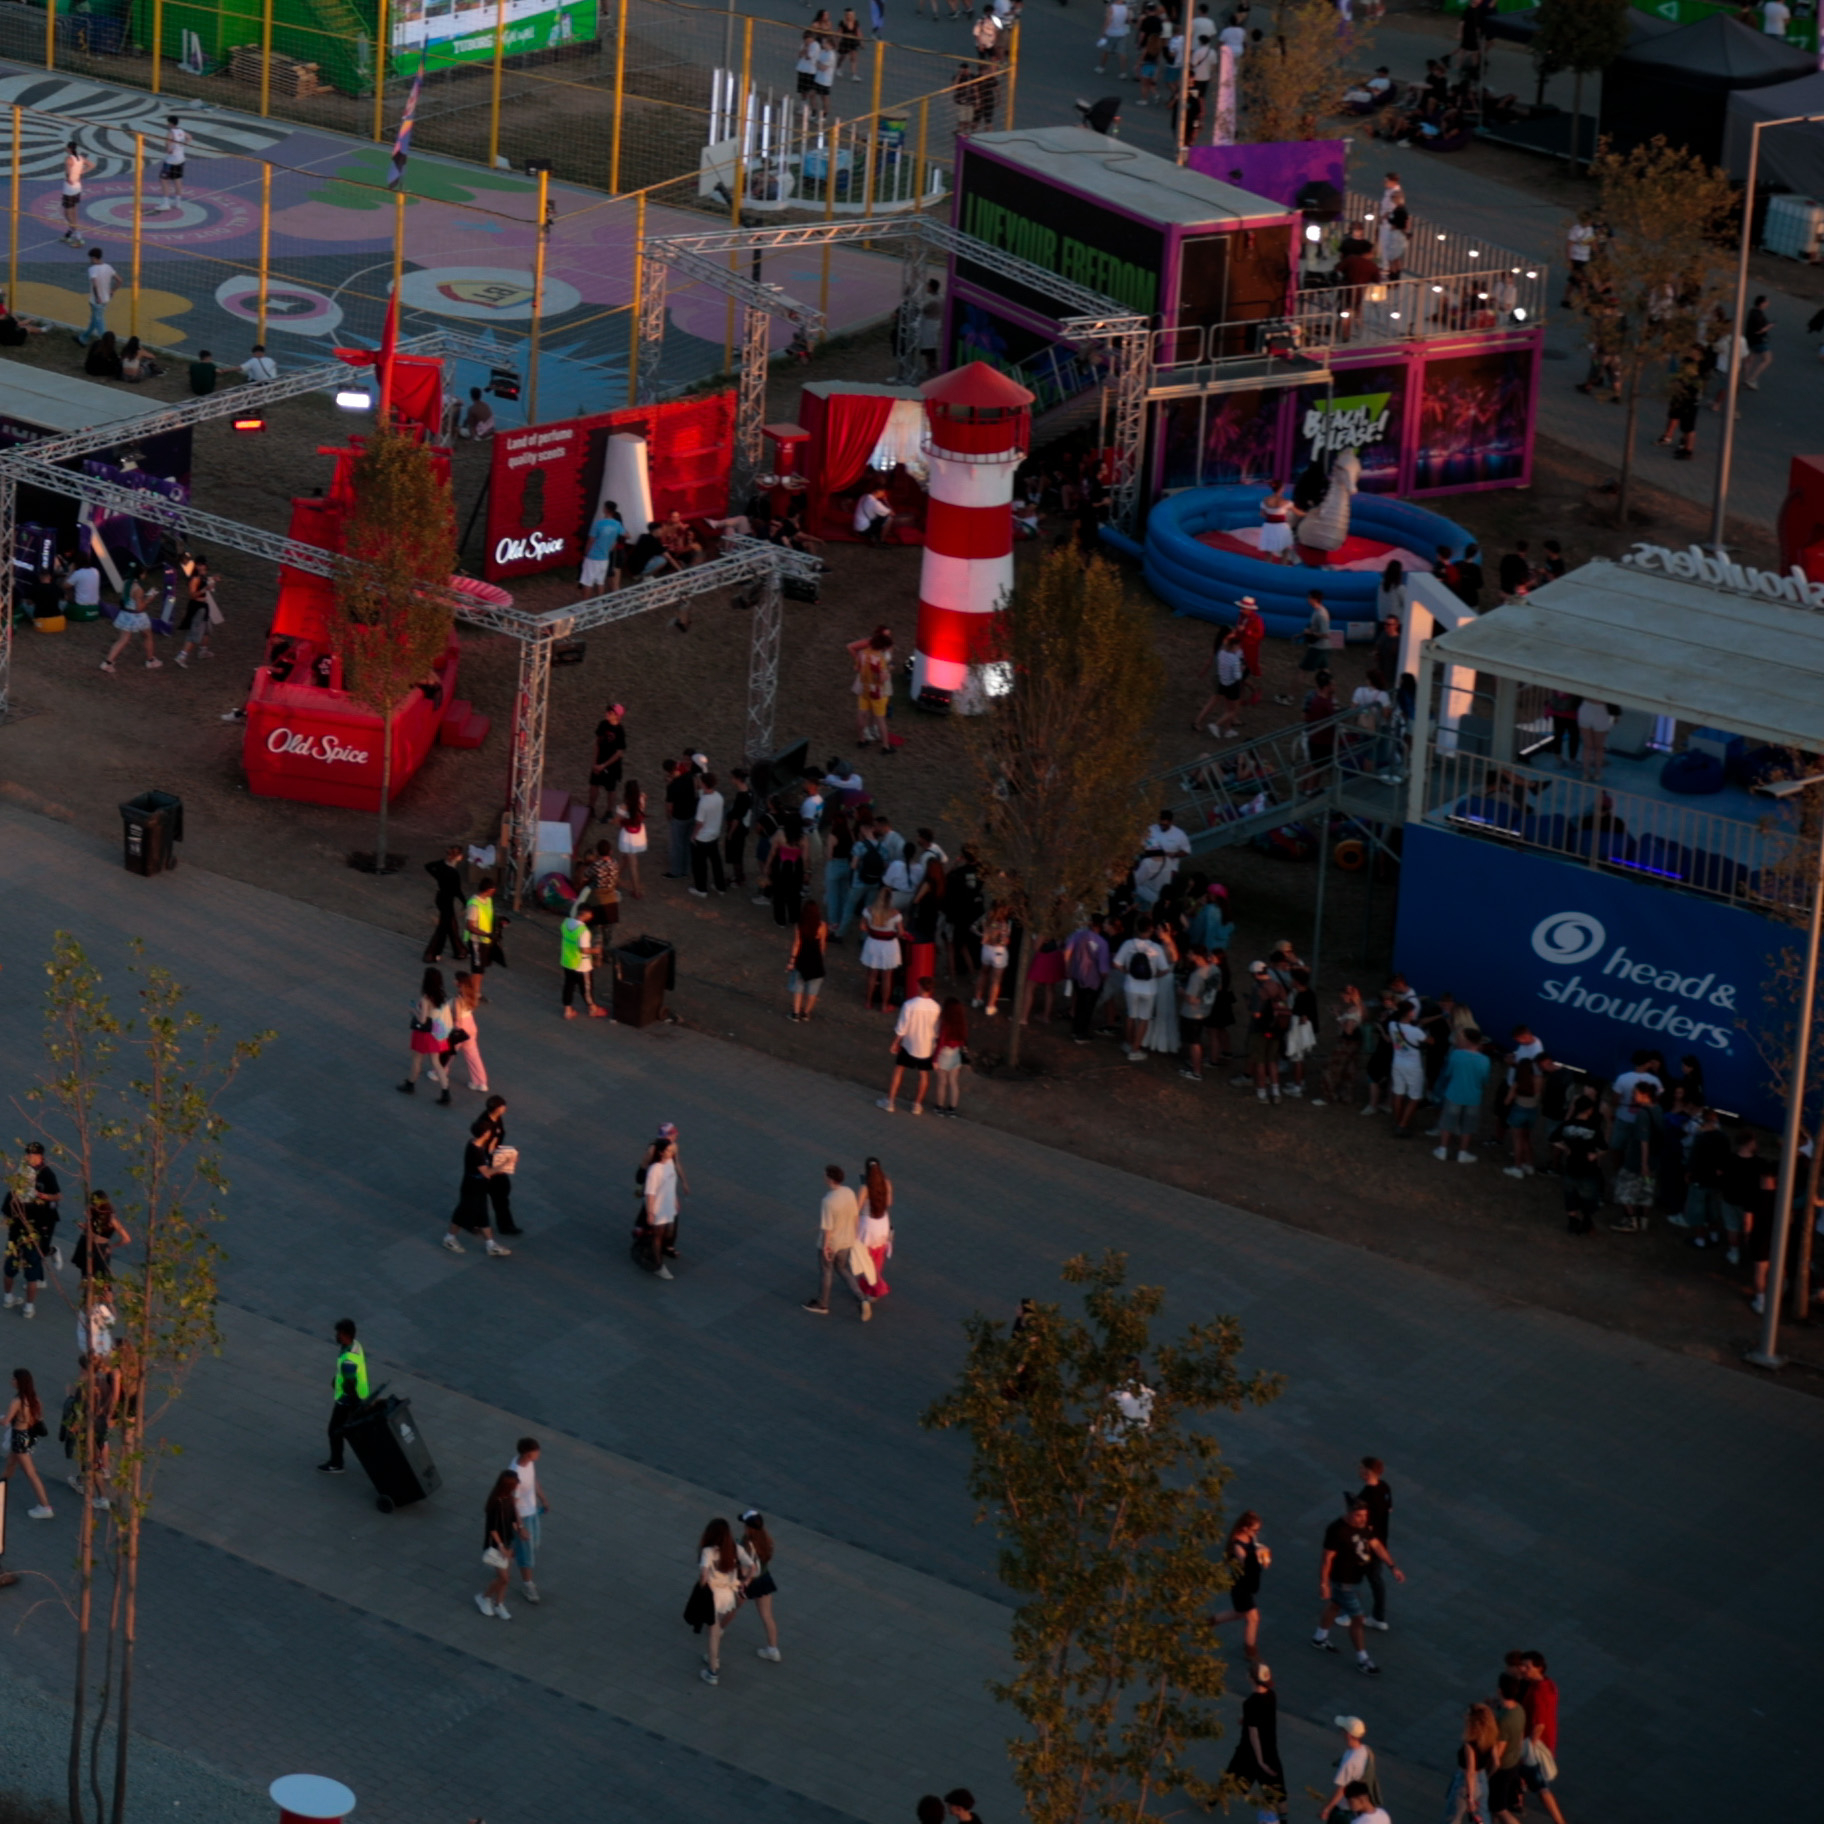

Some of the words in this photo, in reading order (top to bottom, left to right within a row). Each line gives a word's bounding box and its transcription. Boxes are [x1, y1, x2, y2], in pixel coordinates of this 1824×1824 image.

[1060, 235, 1157, 314] FREEDOM
[507, 435, 528, 451] Land
[538, 429, 574, 446] perfume
[507, 451, 537, 469] quality
[538, 447, 566, 462] scents
[495, 537, 526, 564] Old
[525, 531, 565, 561] Spice
[267, 728, 313, 756] Old
[312, 735, 369, 764] Spice
